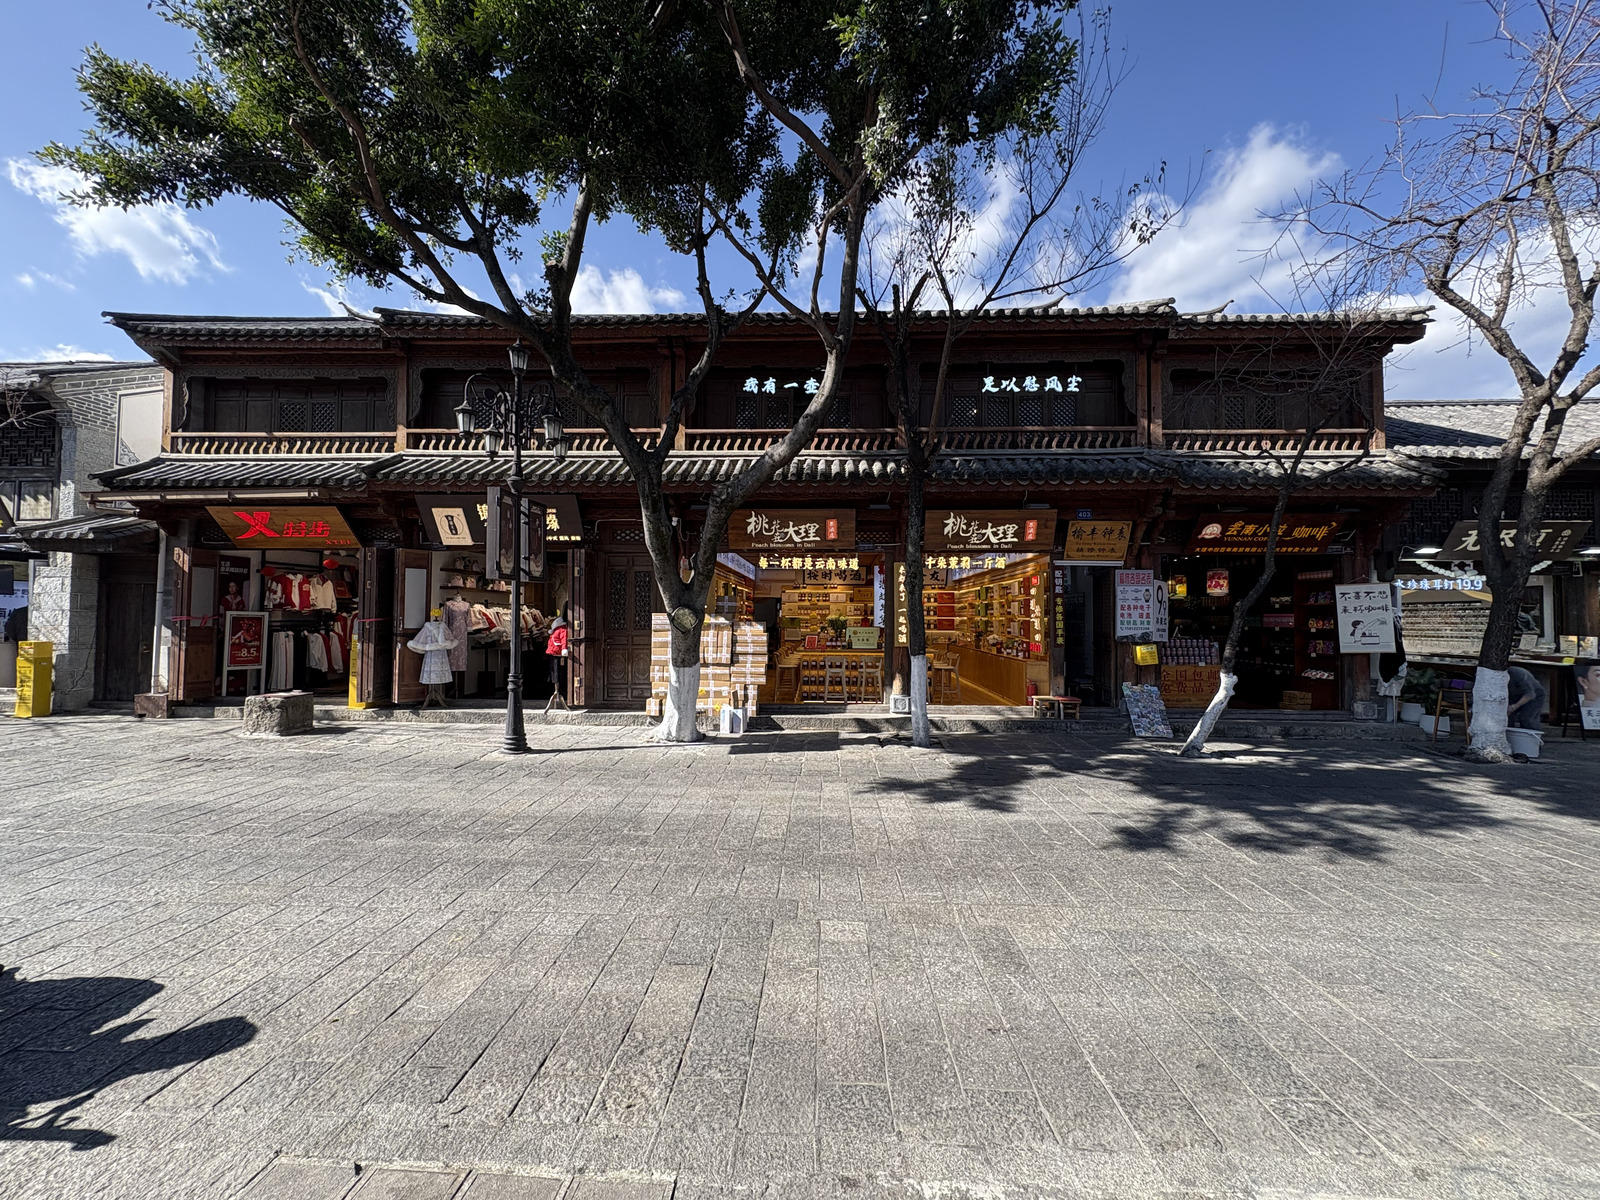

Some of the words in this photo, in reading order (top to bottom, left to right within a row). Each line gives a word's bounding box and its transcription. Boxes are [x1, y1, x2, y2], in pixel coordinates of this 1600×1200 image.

[982, 375, 1082, 393] 足以慰风尘
[282, 521, 330, 538] 特步
[758, 556, 860, 570] 每一杯都是云南味道
[924, 556, 1007, 570] 千朵茉莉一斤酒
[807, 569, 862, 581] 按时喝酒
[1055, 570, 1063, 594] 配钥匙
[1341, 604, 1390, 614] 来杯咖啡
[1161, 669, 1220, 681] 全国包邮
